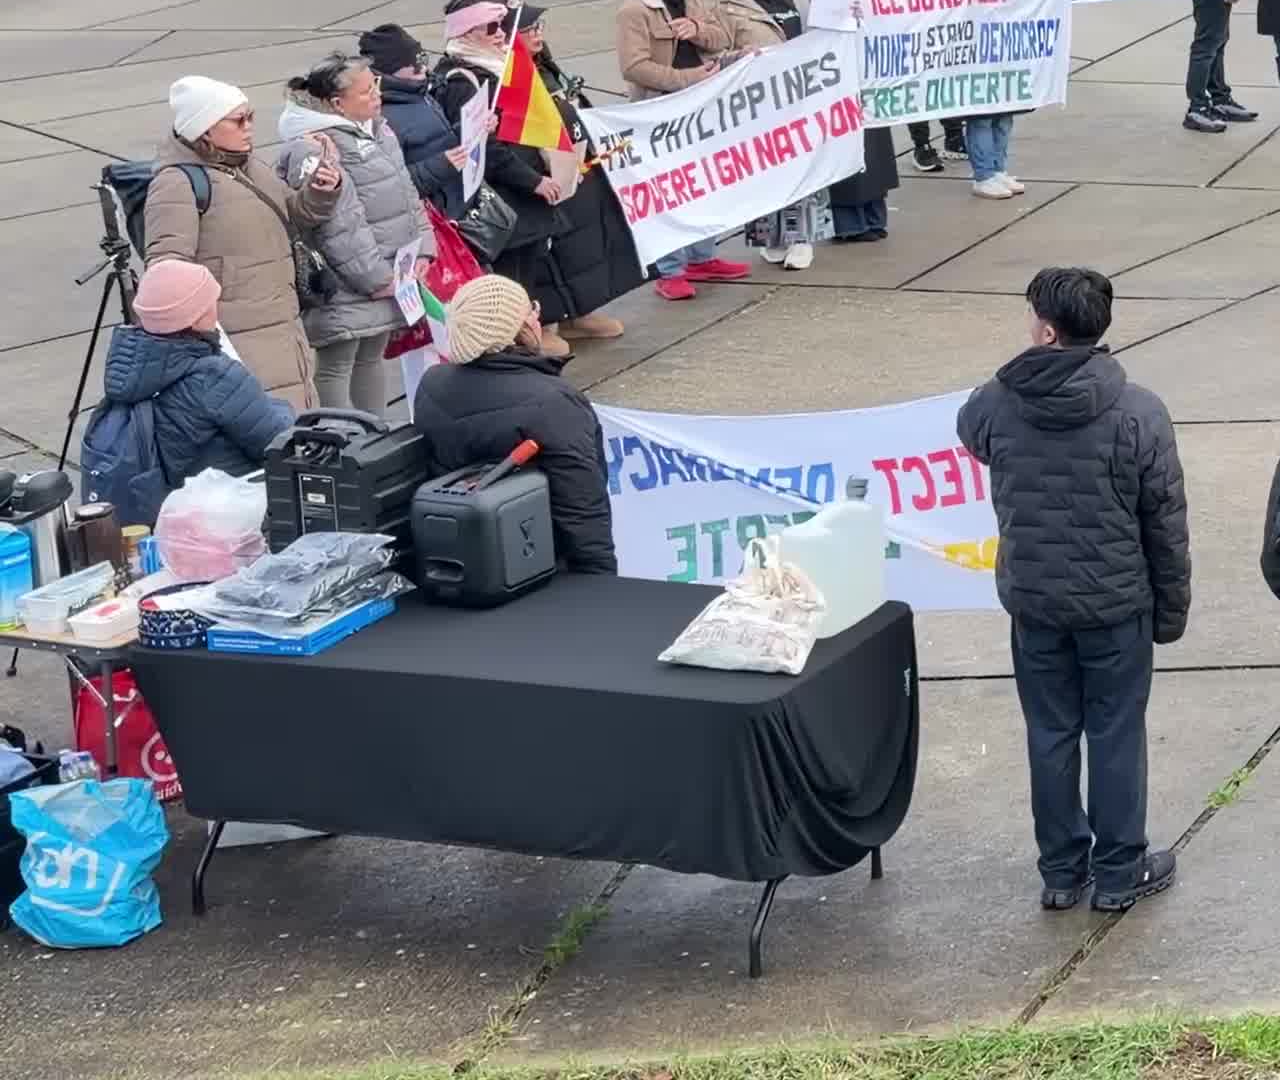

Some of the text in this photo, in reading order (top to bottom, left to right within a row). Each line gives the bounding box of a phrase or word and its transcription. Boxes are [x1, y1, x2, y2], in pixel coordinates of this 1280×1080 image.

[860, 69, 1032, 119] FREE DUTERTE
[864, 30, 921, 79] MONEY
[650, 51, 841, 159] PHILIPPINES
[618, 141, 754, 225] SOVEREIGN
[753, 96, 865, 170] NATION
